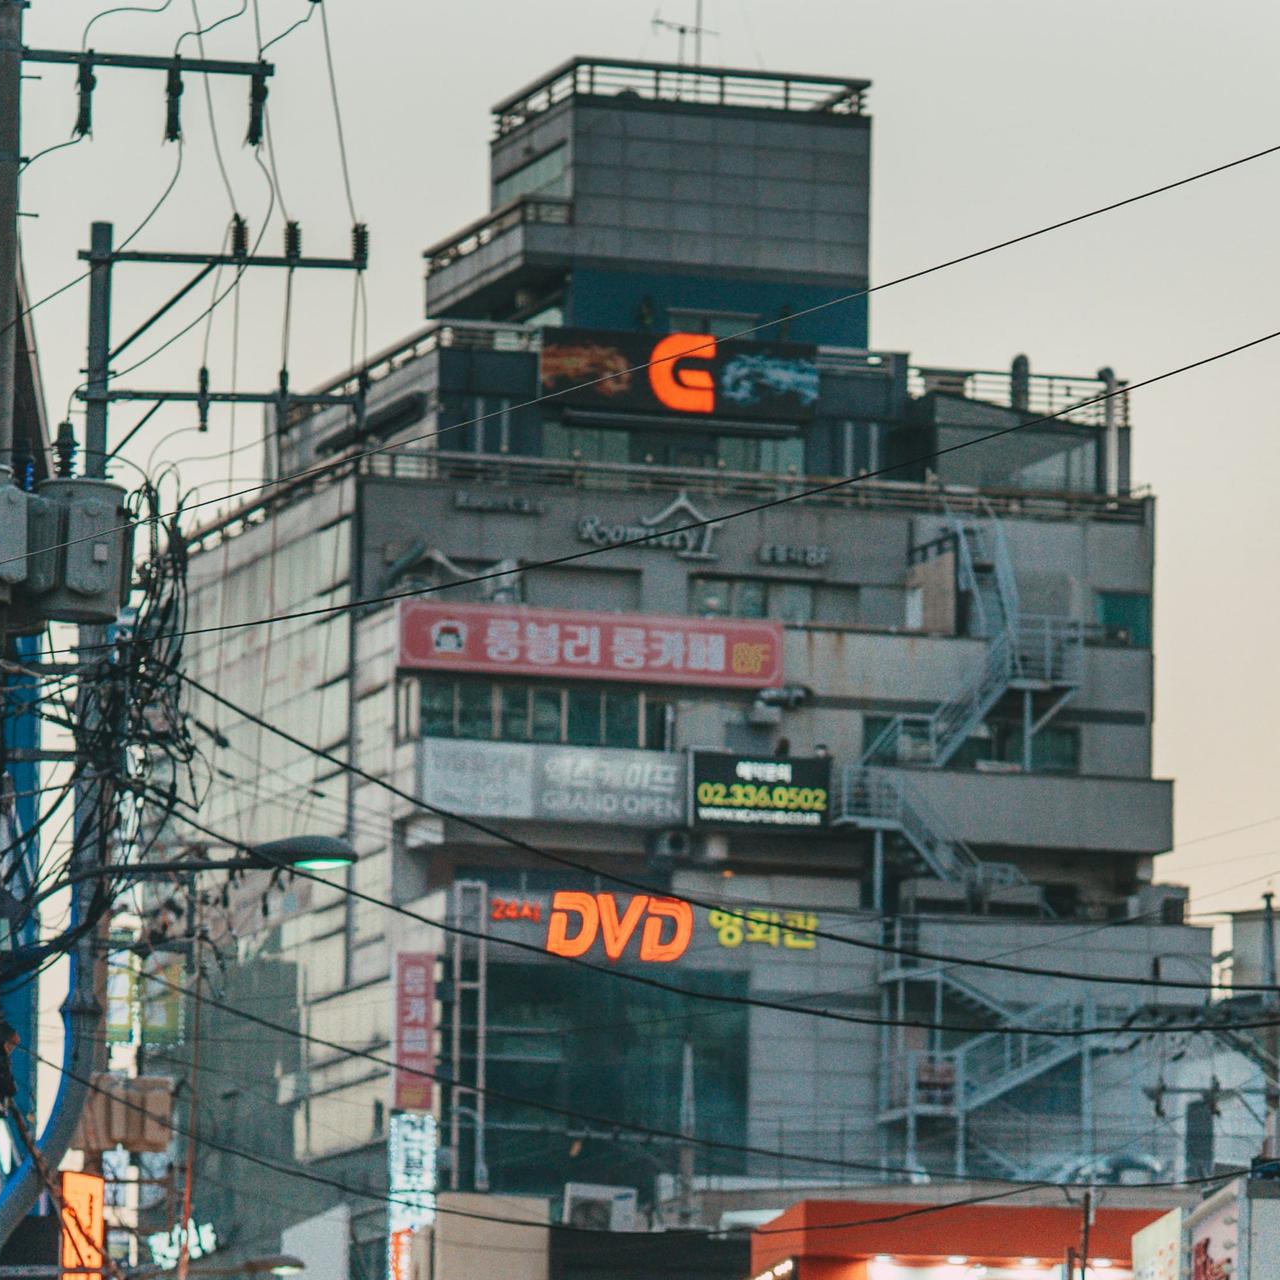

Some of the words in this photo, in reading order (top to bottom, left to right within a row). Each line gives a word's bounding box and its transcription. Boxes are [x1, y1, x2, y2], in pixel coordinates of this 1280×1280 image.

[697, 782, 828, 812] 02.336.0502
[546, 889, 694, 963] DVD
[709, 907, 818, 950] 영화관
